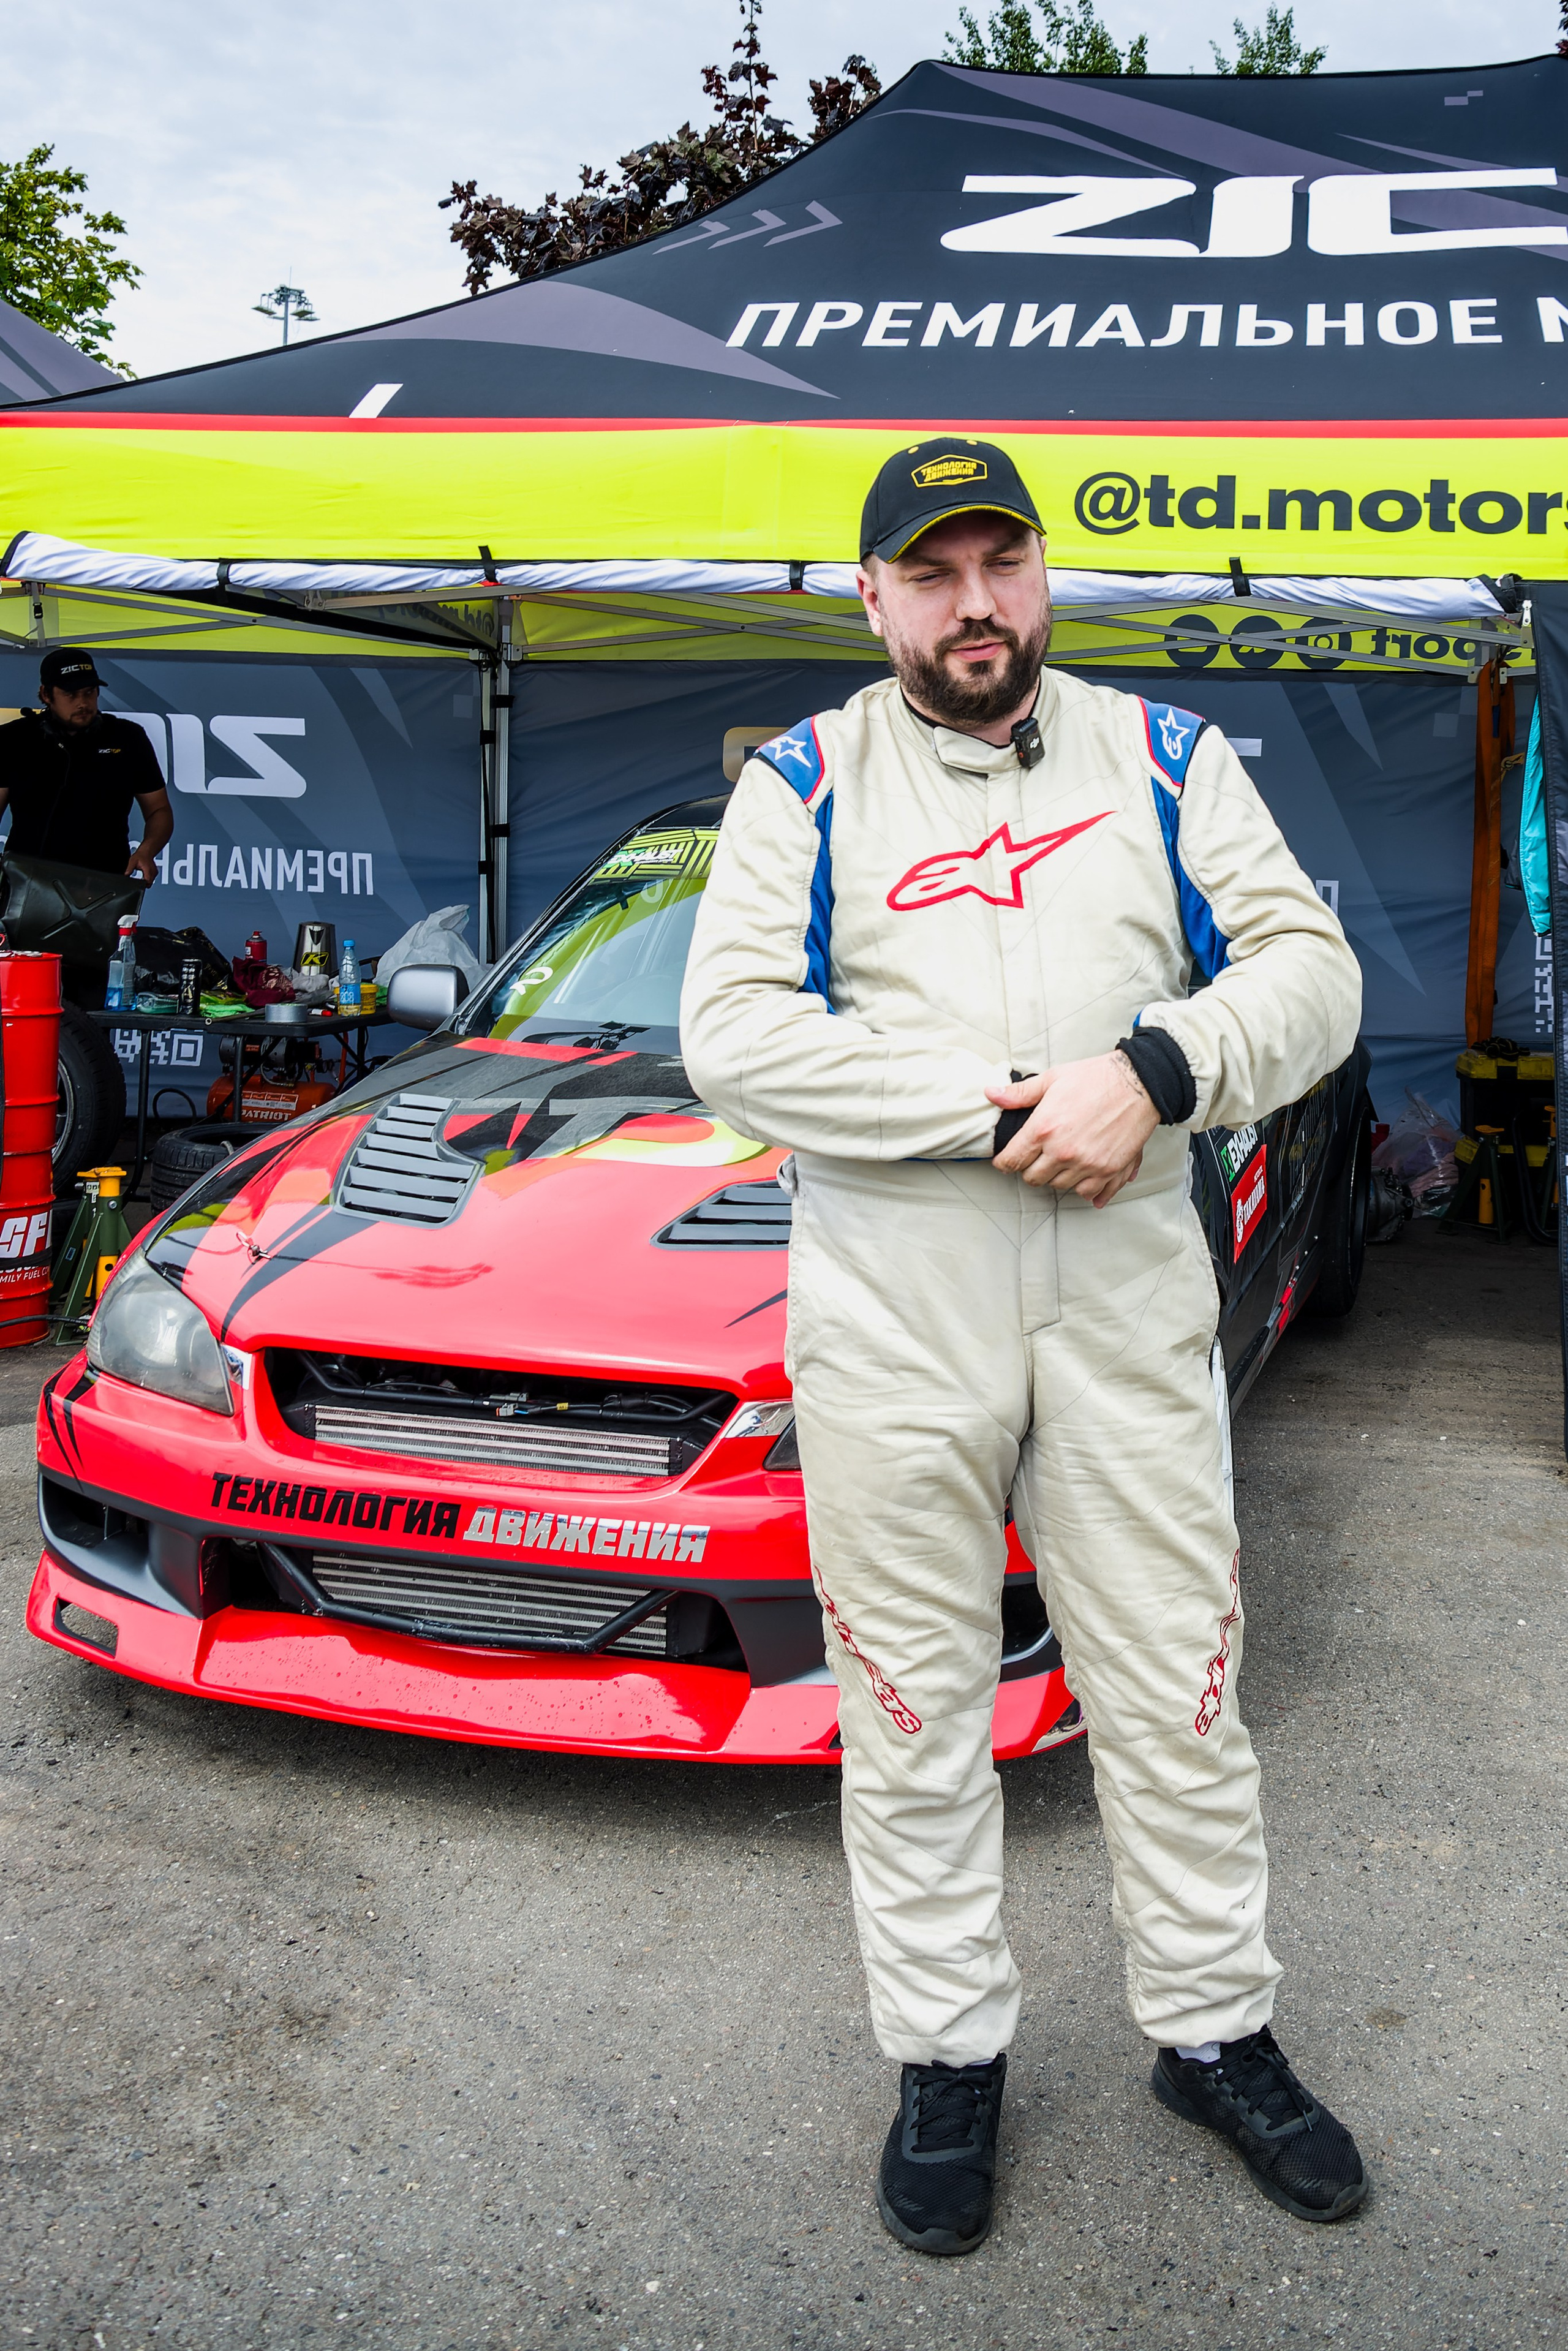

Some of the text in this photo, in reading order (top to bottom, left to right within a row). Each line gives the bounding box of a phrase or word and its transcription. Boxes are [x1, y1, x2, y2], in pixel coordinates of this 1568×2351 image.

[940, 168, 1568, 258] ZIC
[726, 298, 1503, 347] ПРЕМИАЛЬНОЕ
[921, 461, 977, 476] ТЕХНОЛОГИЯ
[923, 467, 974, 483] ДВИЖЕНИЯ
[1075, 471, 1568, 535] @td.motor
[23, 1270, 40, 1280] FUEL
[211, 1471, 711, 1563] ТЕХНОЛОГИЯ ДВИЖЕНИЯ
